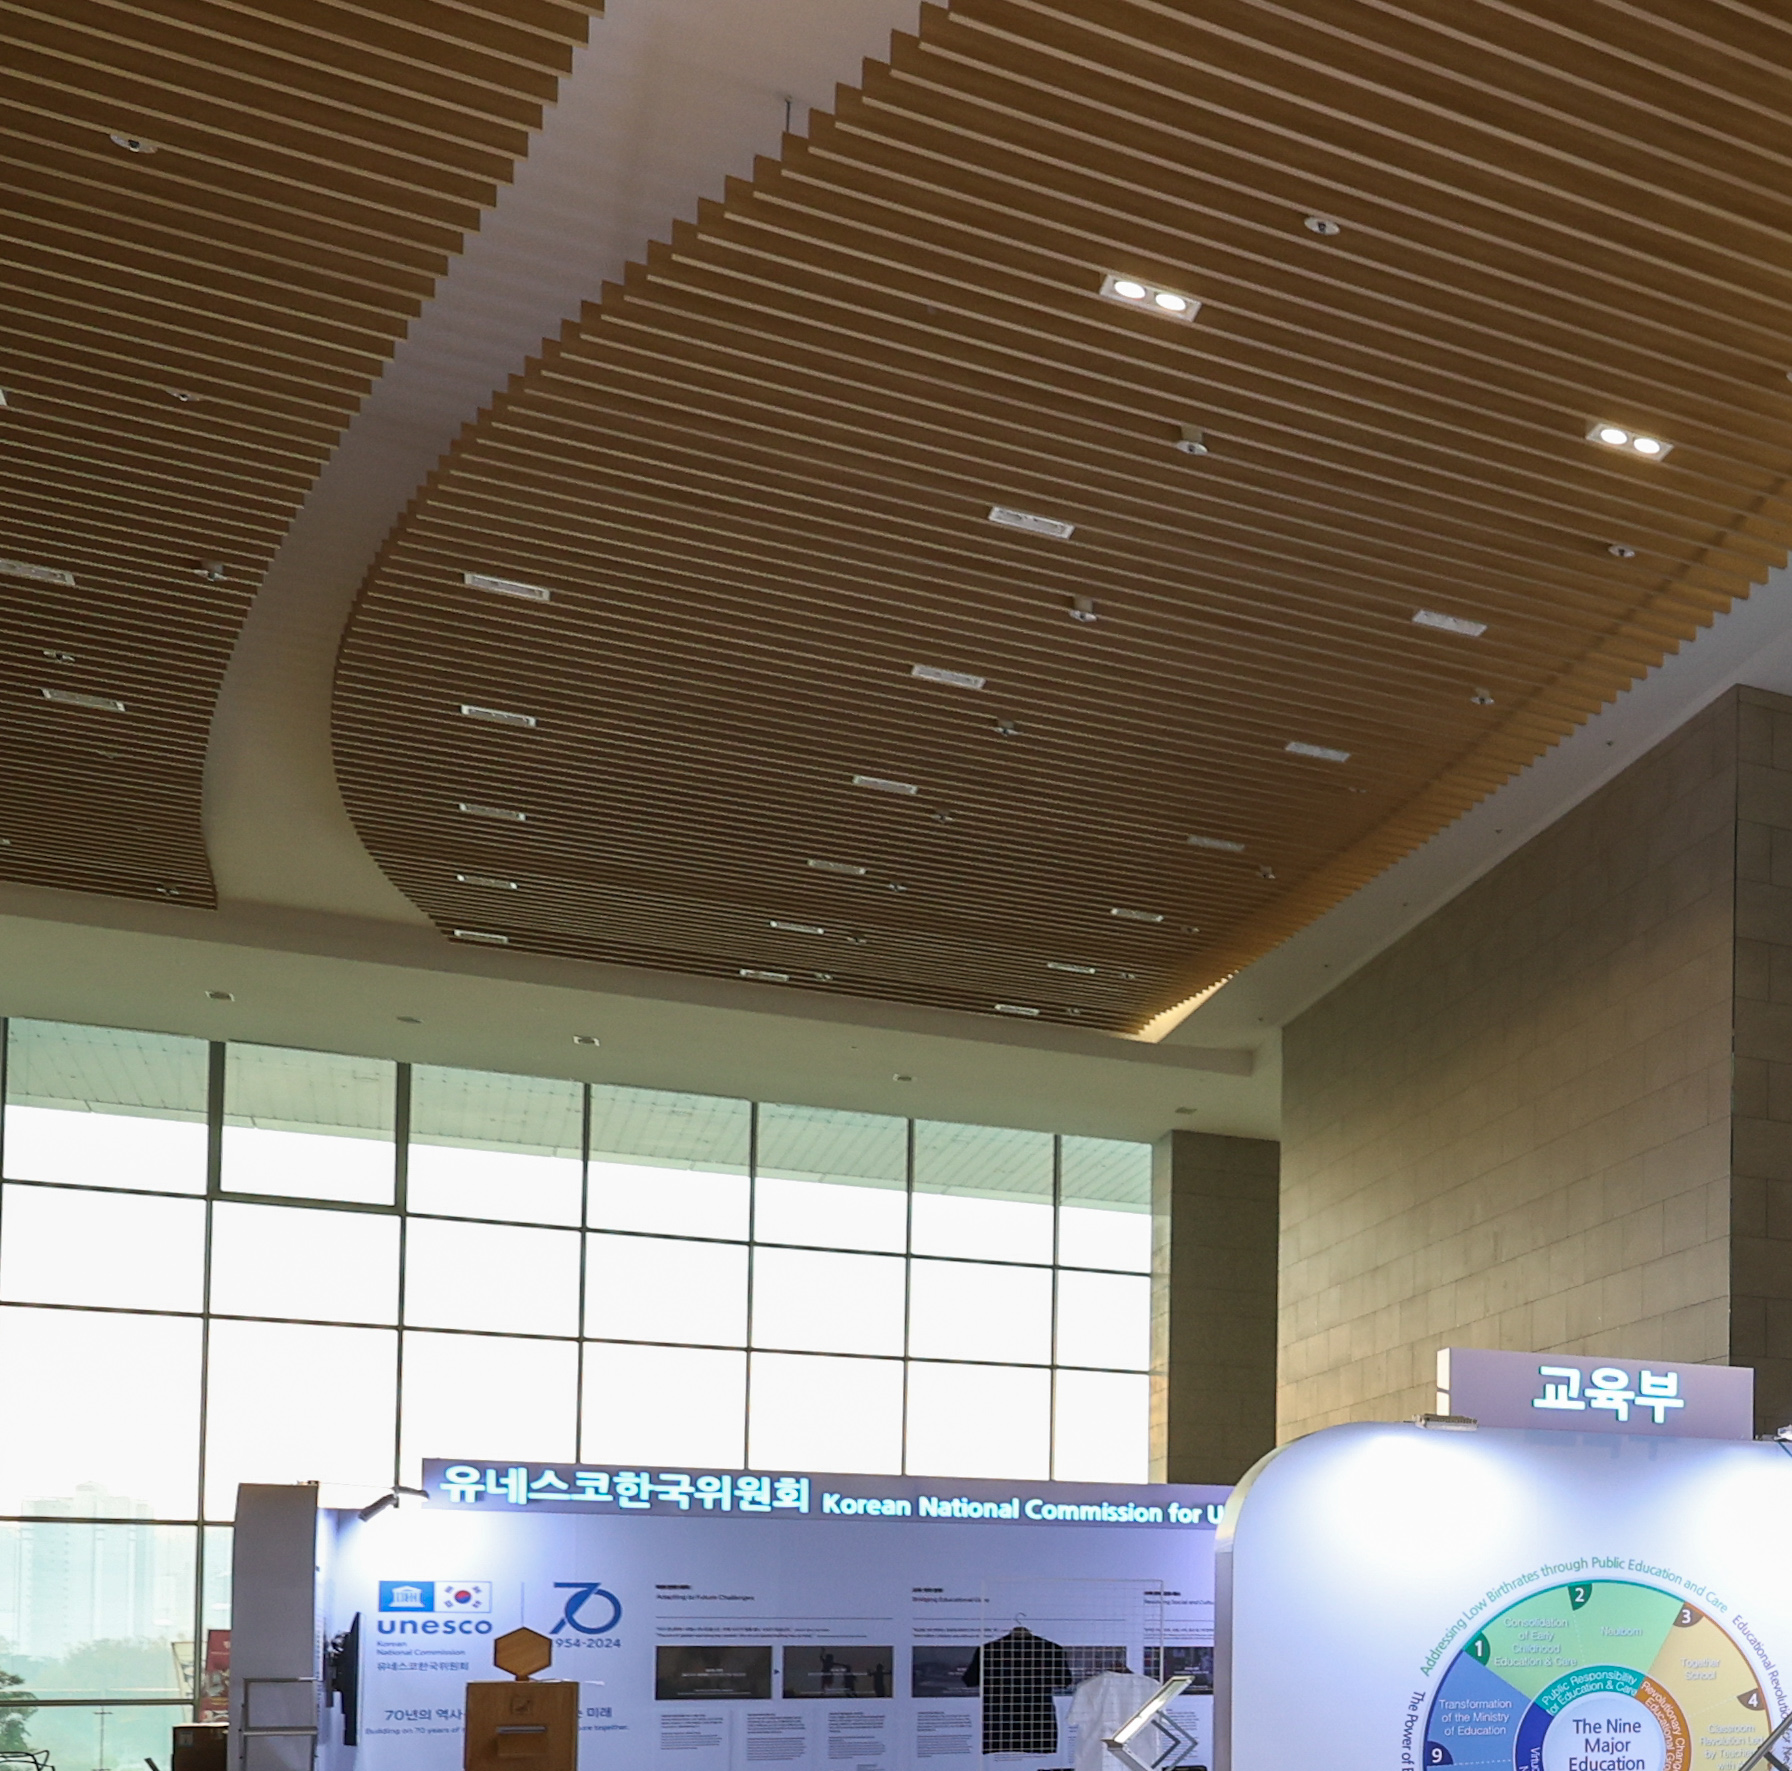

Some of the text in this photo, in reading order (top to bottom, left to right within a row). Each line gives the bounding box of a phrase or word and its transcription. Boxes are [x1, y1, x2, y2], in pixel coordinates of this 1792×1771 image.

[1532, 1367, 1685, 1424] 교육부
[439, 1465, 811, 1513] 유네스코한국위원회
[822, 1493, 912, 1516] Korean
[918, 1496, 1020, 1519] National
[1025, 1499, 1163, 1522] Commission
[1167, 1502, 1203, 1524] for
[1574, 1587, 1585, 1603] 2
[1420, 1556, 1729, 1677] Addressing Low Birthrates through Public Education and Care
[1681, 1609, 1691, 1624] 3
[377, 1619, 493, 1635] unesco
[1474, 1640, 1483, 1657] 1
[1438, 1699, 1512, 1710] Transformation
[1748, 1693, 1758, 1707] 4
[1441, 1712, 1511, 1724] of the Ministry
[1572, 1718, 1642, 1734] The Nine
[1444, 1725, 1506, 1736] of Education
[1584, 1737, 1631, 1755] Major
[1431, 1747, 1443, 1764] 9
[1569, 1756, 1645, 1771] Education
